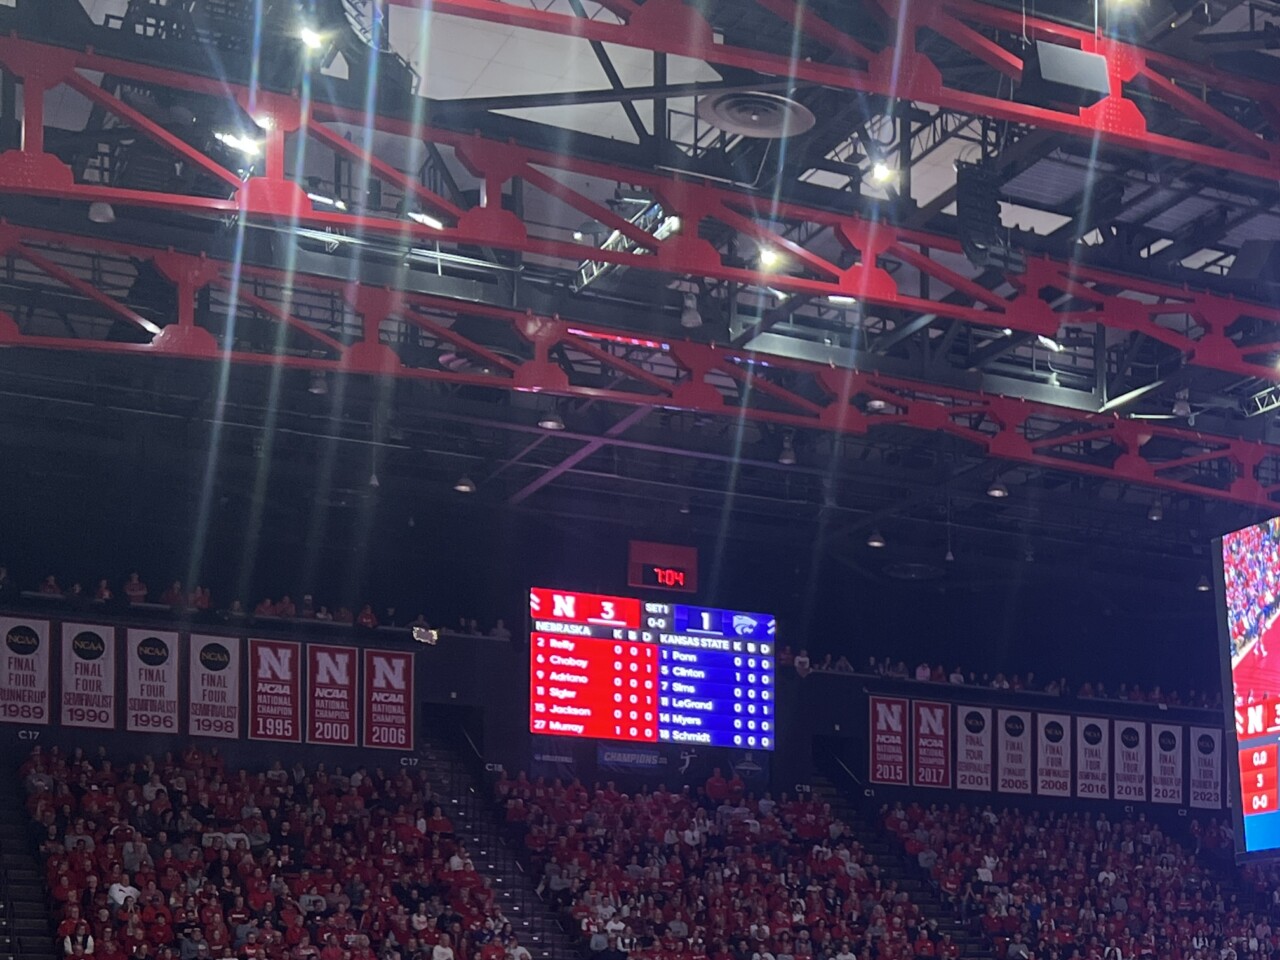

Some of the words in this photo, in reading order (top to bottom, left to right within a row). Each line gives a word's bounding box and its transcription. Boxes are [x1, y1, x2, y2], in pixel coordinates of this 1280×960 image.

[653, 568, 685, 587] 7:04
[553, 594, 575, 618] N
[600, 601, 615, 619] 3
[645, 602, 663, 614] SET
[535, 621, 592, 636] NEBRASKA
[647, 617, 666, 629] 0-0
[701, 612, 710, 630] 1
[7, 633, 37, 645] NCAA
[74, 640, 104, 652] NCAA
[660, 633, 700, 647] KANSAS
[700, 637, 730, 650] STATE
[139, 646, 168, 657] NCAA
[201, 650, 229, 662] NCAA
[8, 657, 36, 672] FINAL
[74, 662, 103, 677] FINAL
[257, 646, 292, 681] N
[316, 652, 349, 686] N
[8, 673, 36, 687] FOUR
[138, 668, 167, 683] FINAL
[372, 656, 406, 690] N
[75, 678, 102, 692] FOUR
[201, 673, 228, 689] FINAL
[140, 683, 165, 698] FOUR
[202, 689, 227, 703] FOUR
[257, 683, 291, 695] NCAA
[314, 687, 348, 700] NCAA
[257, 695, 293, 706] NATIONAL
[315, 699, 350, 711] NATIONAL
[371, 692, 405, 704] NCAA
[1, 703, 44, 719] 1989
[68, 708, 110, 723] 1990
[371, 703, 406, 716] NATIONAL
[132, 713, 174, 728] 1996
[876, 703, 902, 732] N
[919, 706, 945, 736] N
[1247, 705, 1263, 733] N
[194, 718, 235, 733] 1998
[257, 717, 293, 737] 1995
[315, 722, 349, 740] 2000
[372, 726, 406, 745] 2006
[672, 730, 711, 743] Schmidt
[876, 764, 903, 780] 2015
[918, 767, 945, 784] 2017
[960, 774, 990, 786] 2001
[1001, 779, 1029, 790] 2005
